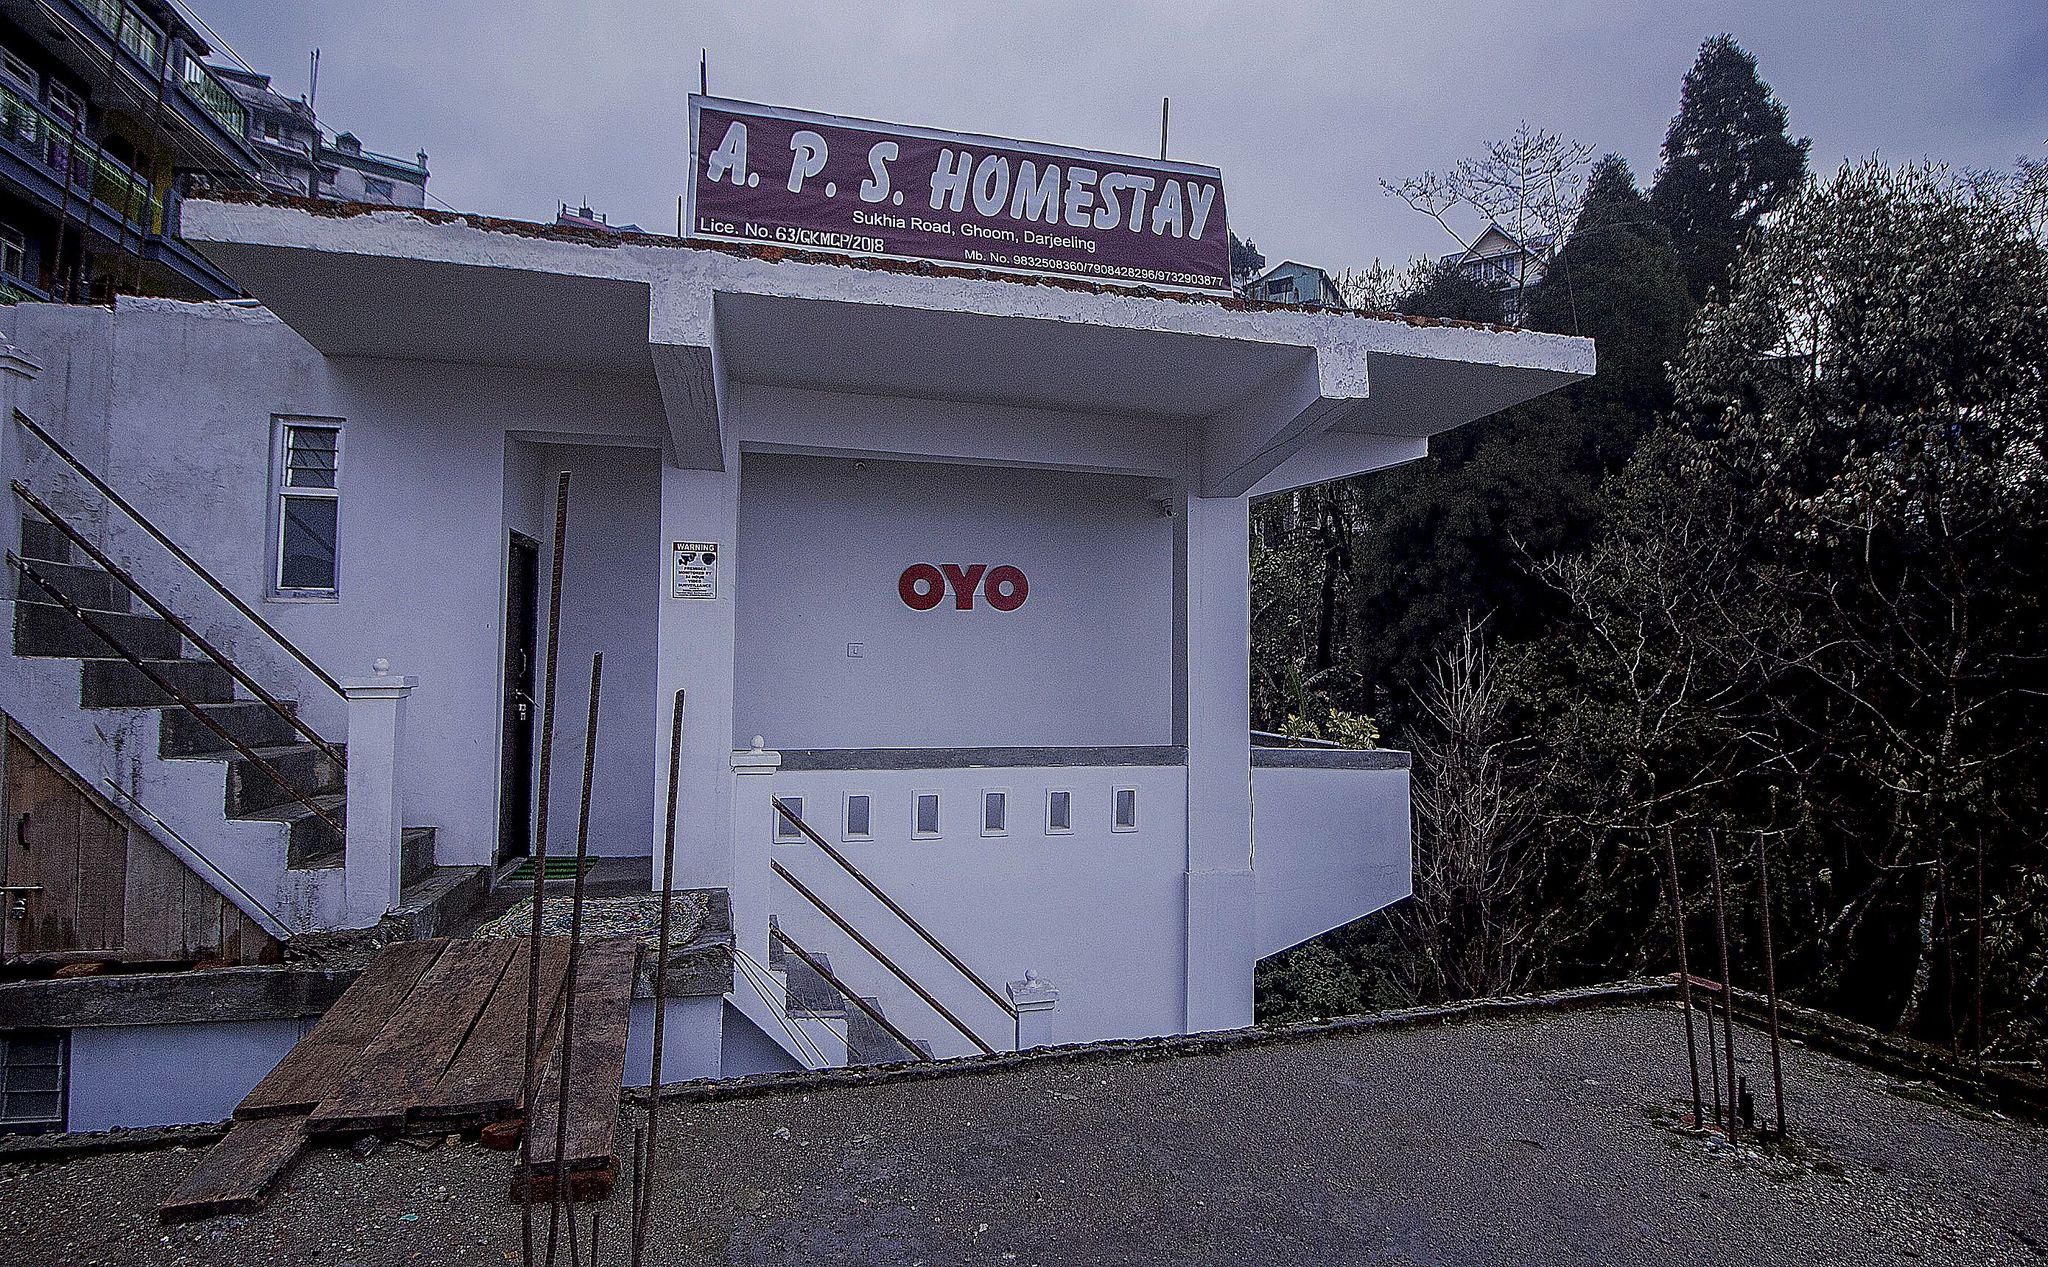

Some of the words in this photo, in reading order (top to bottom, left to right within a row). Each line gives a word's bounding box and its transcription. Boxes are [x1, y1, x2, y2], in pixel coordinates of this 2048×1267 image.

[706, 121, 760, 188] A.
[787, 130, 837, 198] P.
[860, 141, 904, 206] S.
[929, 148, 1216, 240] HOMESTAY
[700, 217, 739, 235] Lice.
[745, 222, 773, 239] No.
[852, 210, 906, 229] Sukhia
[910, 217, 956, 237] Road,
[960, 223, 1019, 244] Ghoom,
[1024, 230, 1096, 253] Darjeeling
[964, 249, 986, 261] Mb.
[990, 252, 1010, 264] No.
[1013, 255, 1223, 286] 9832508360/7908428296/9732903877
[677, 543, 715, 551] WARNING
[899, 563, 1029, 612] OYO
